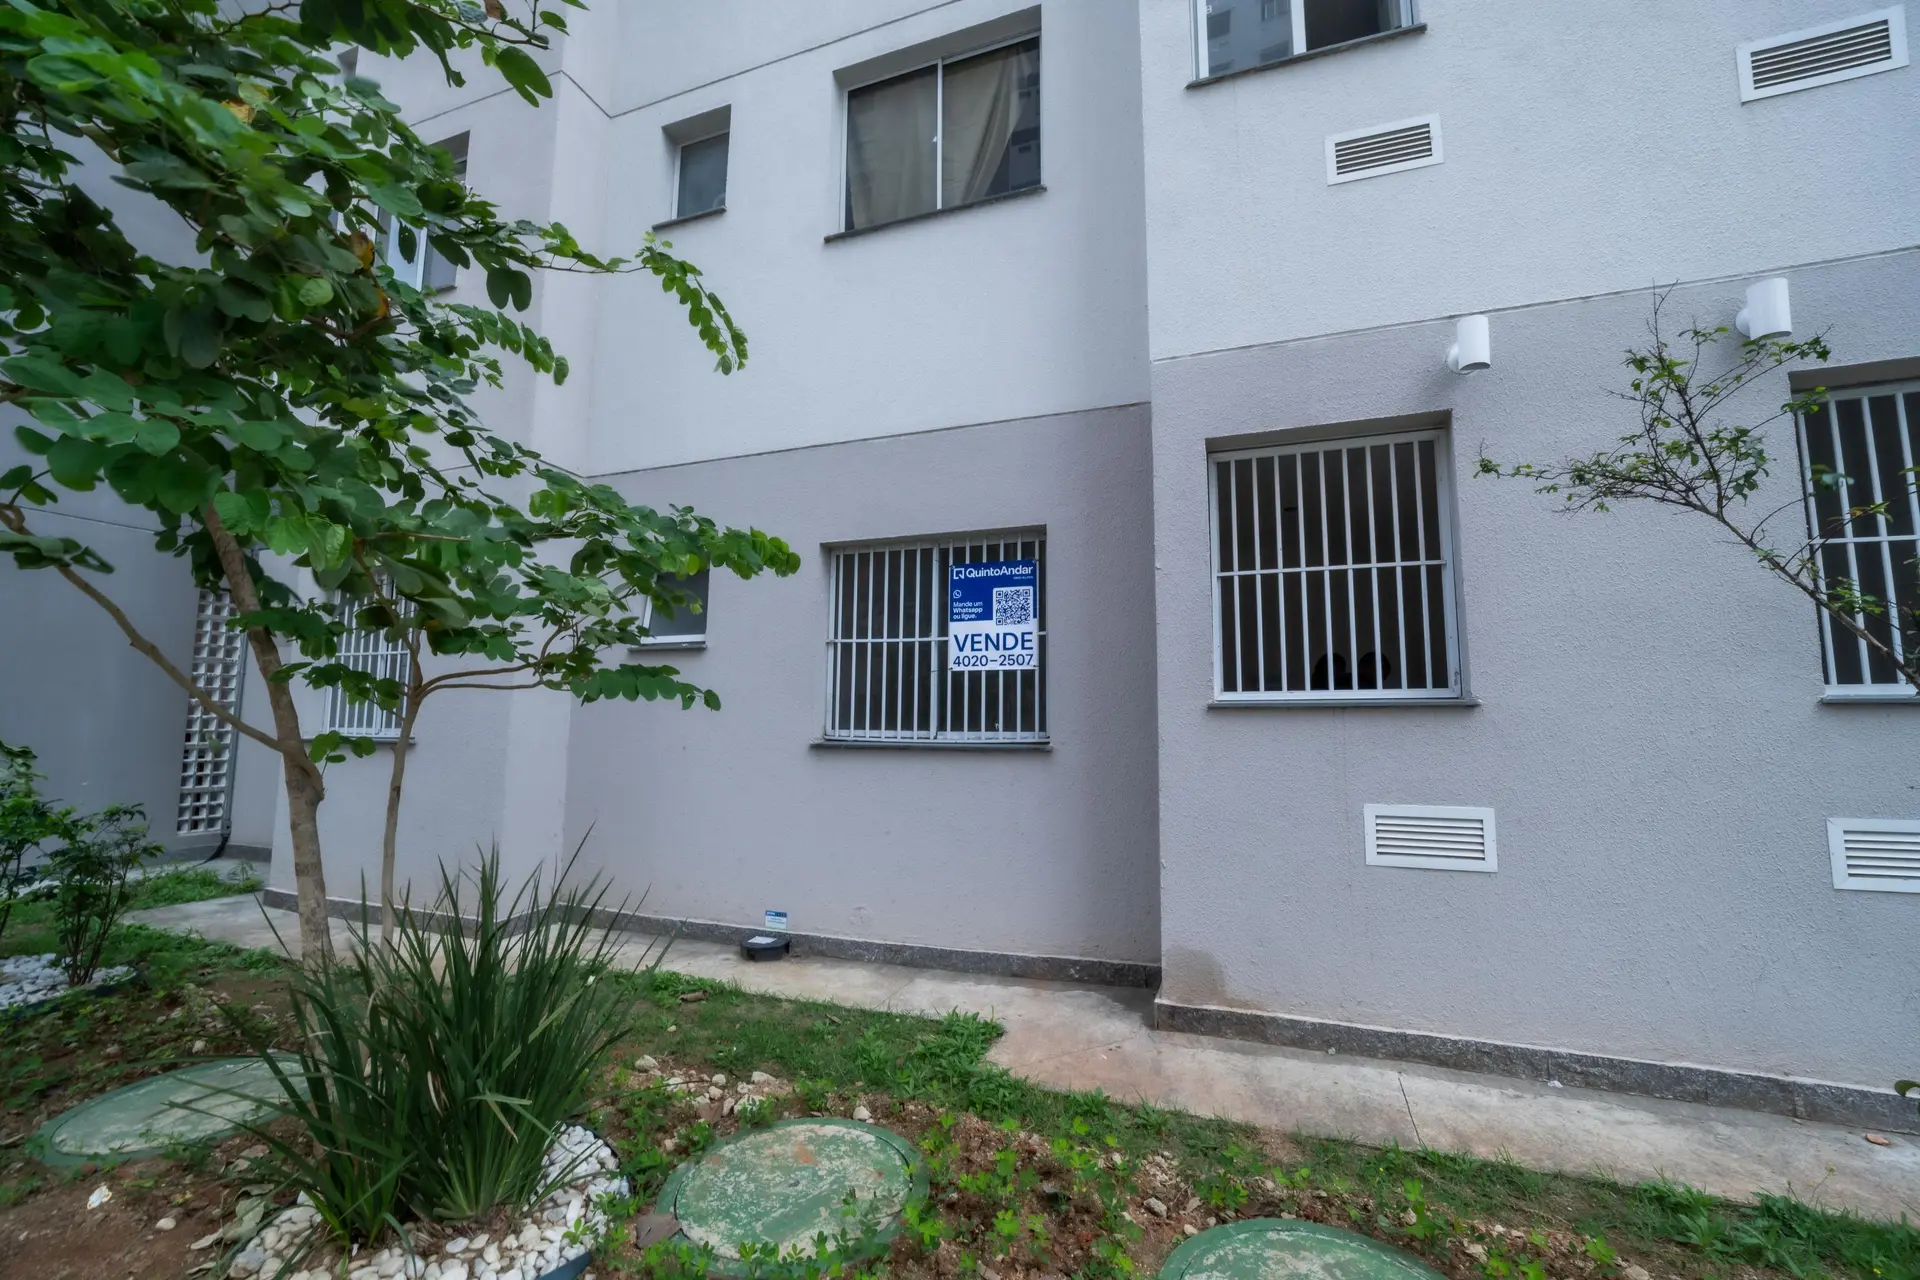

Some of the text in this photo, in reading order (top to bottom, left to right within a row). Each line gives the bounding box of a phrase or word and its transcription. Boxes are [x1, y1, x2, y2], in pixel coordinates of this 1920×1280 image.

[966, 565, 1033, 578] QuintoAndar
[953, 632, 1034, 653] VENDE
[953, 653, 1034, 667] 4020-2507
